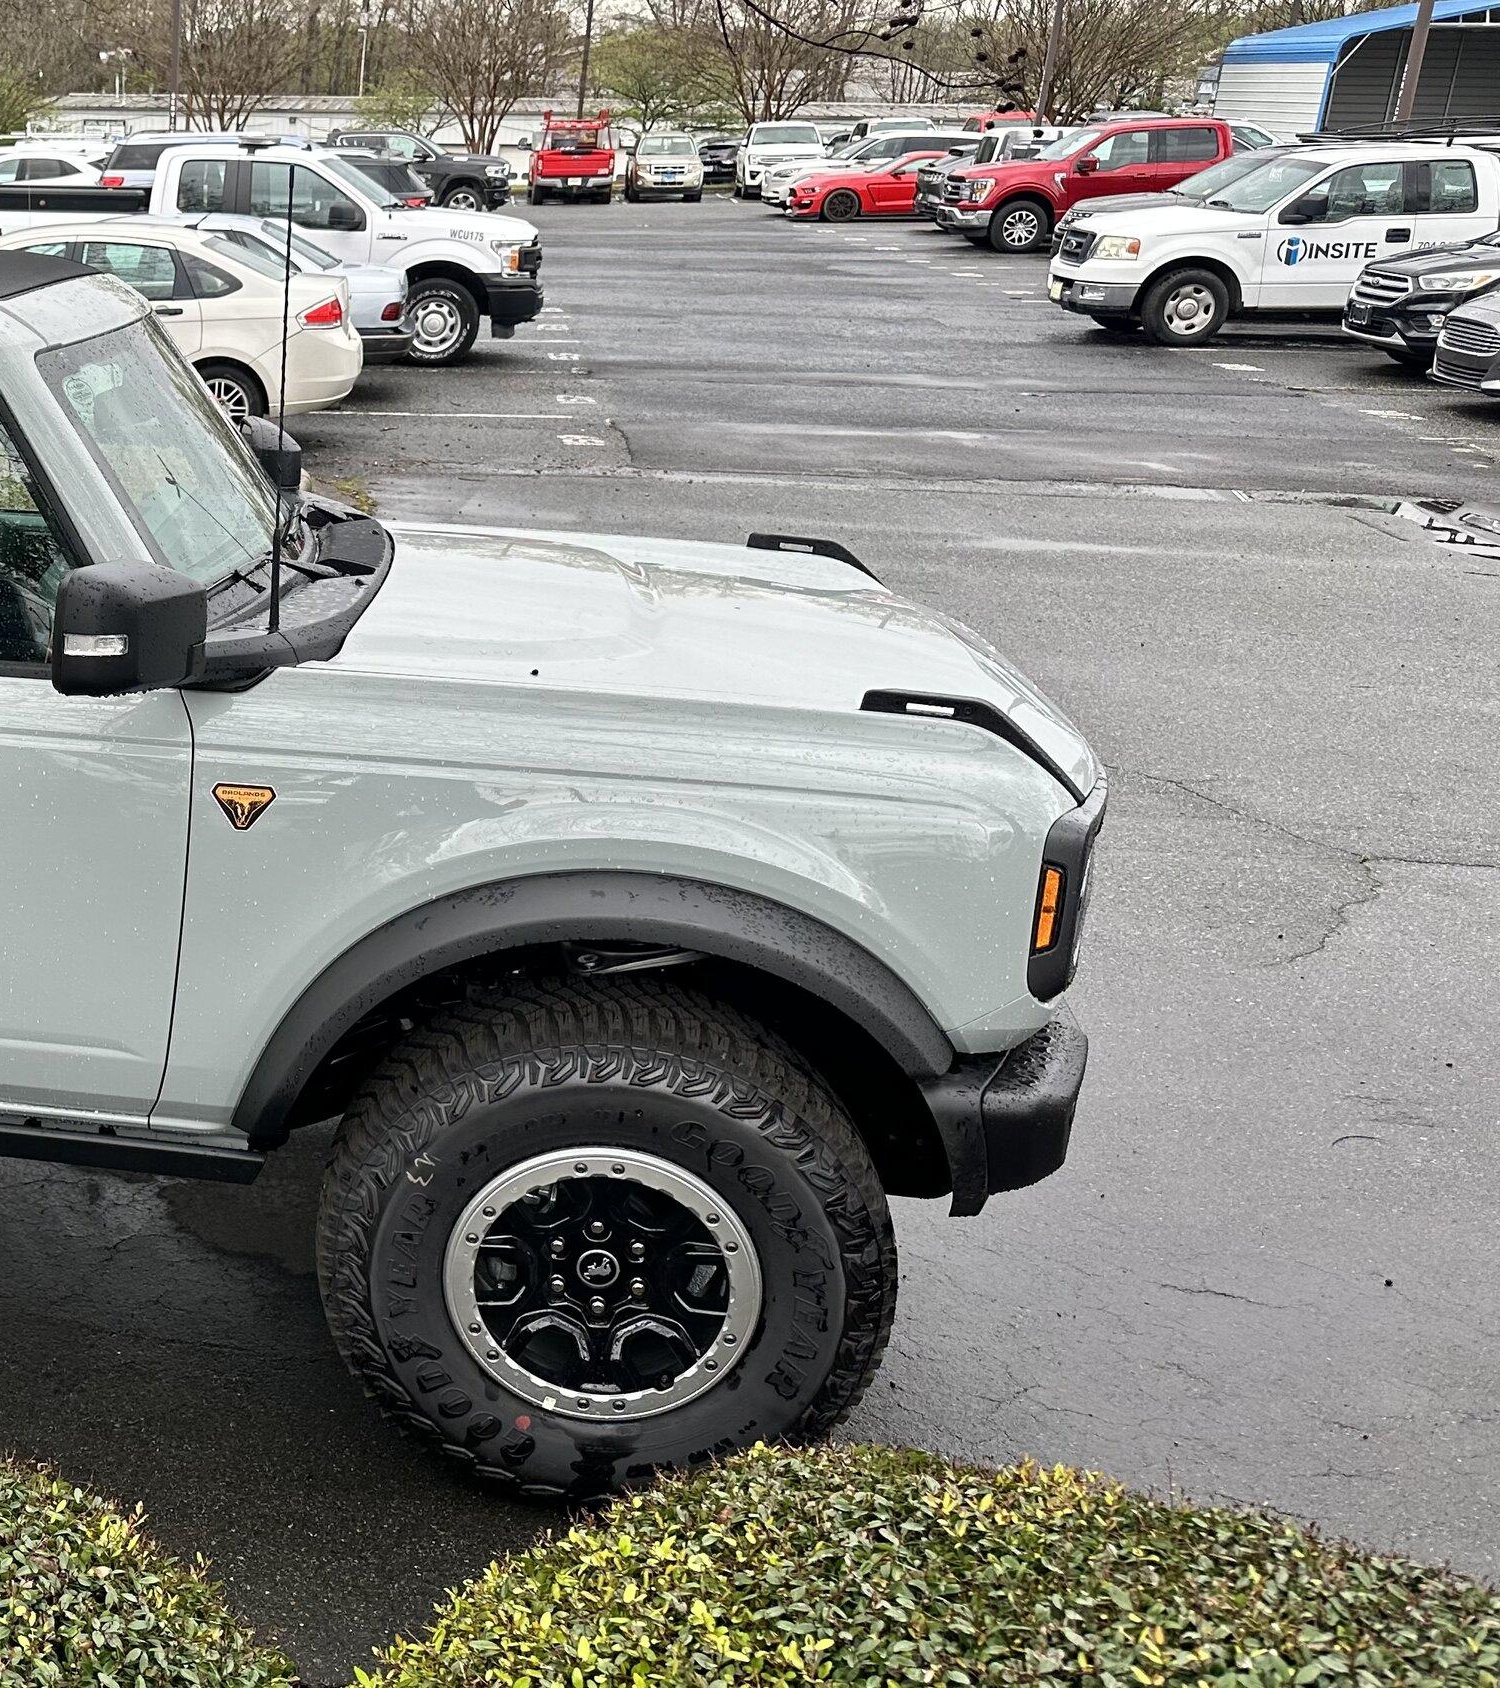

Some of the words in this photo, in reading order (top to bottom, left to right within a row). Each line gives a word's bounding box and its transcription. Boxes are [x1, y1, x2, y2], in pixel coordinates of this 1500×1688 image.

[449, 228, 484, 241] WCU175
[1308, 242, 1377, 259] INSITE
[221, 789, 266, 797] BADLANDS
